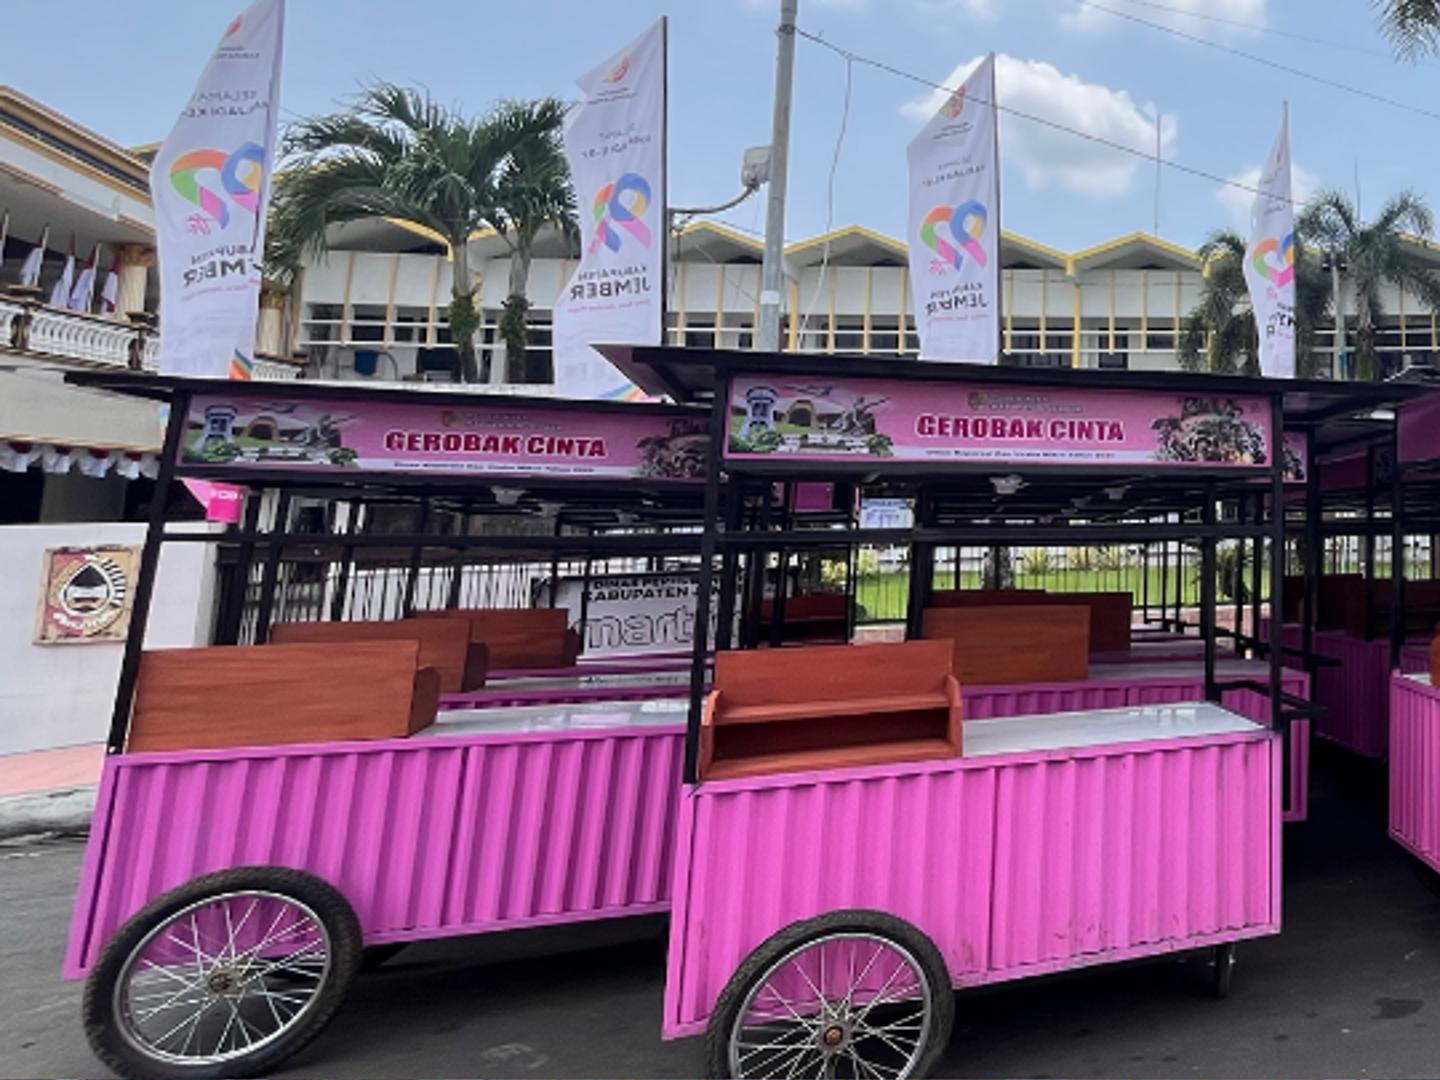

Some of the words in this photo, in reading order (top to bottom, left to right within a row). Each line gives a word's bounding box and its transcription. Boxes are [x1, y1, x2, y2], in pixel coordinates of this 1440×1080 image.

[384, 426, 523, 455] GEROBAK
[526, 433, 608, 458] CINTA
[917, 414, 1044, 440] GEROBAK
[1049, 419, 1125, 442] CINTA
